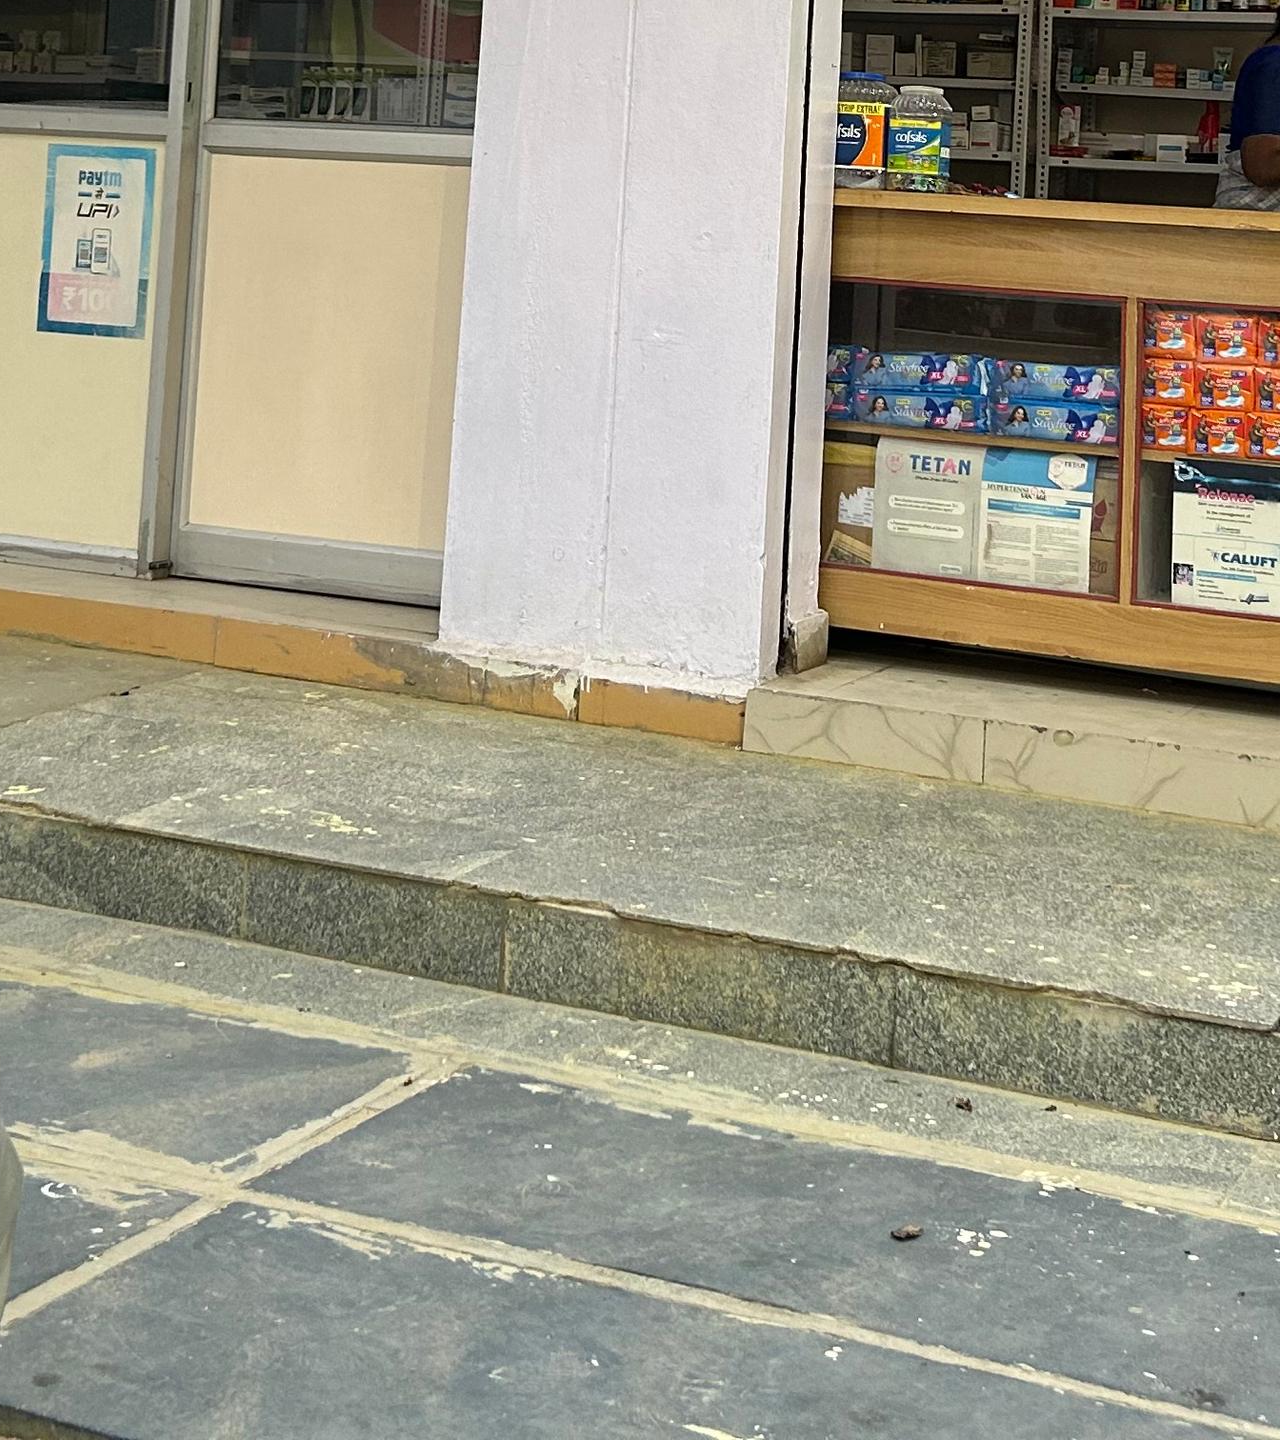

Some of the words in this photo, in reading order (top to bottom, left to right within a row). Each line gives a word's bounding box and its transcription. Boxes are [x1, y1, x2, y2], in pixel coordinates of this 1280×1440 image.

[77, 203, 113, 219] UPI
[930, 372, 942, 380] XL
[1074, 385, 1086, 393] XL
[1076, 430, 1088, 438] XL
[910, 454, 971, 476] TETAN
[1221, 553, 1278, 568] CALUFT
